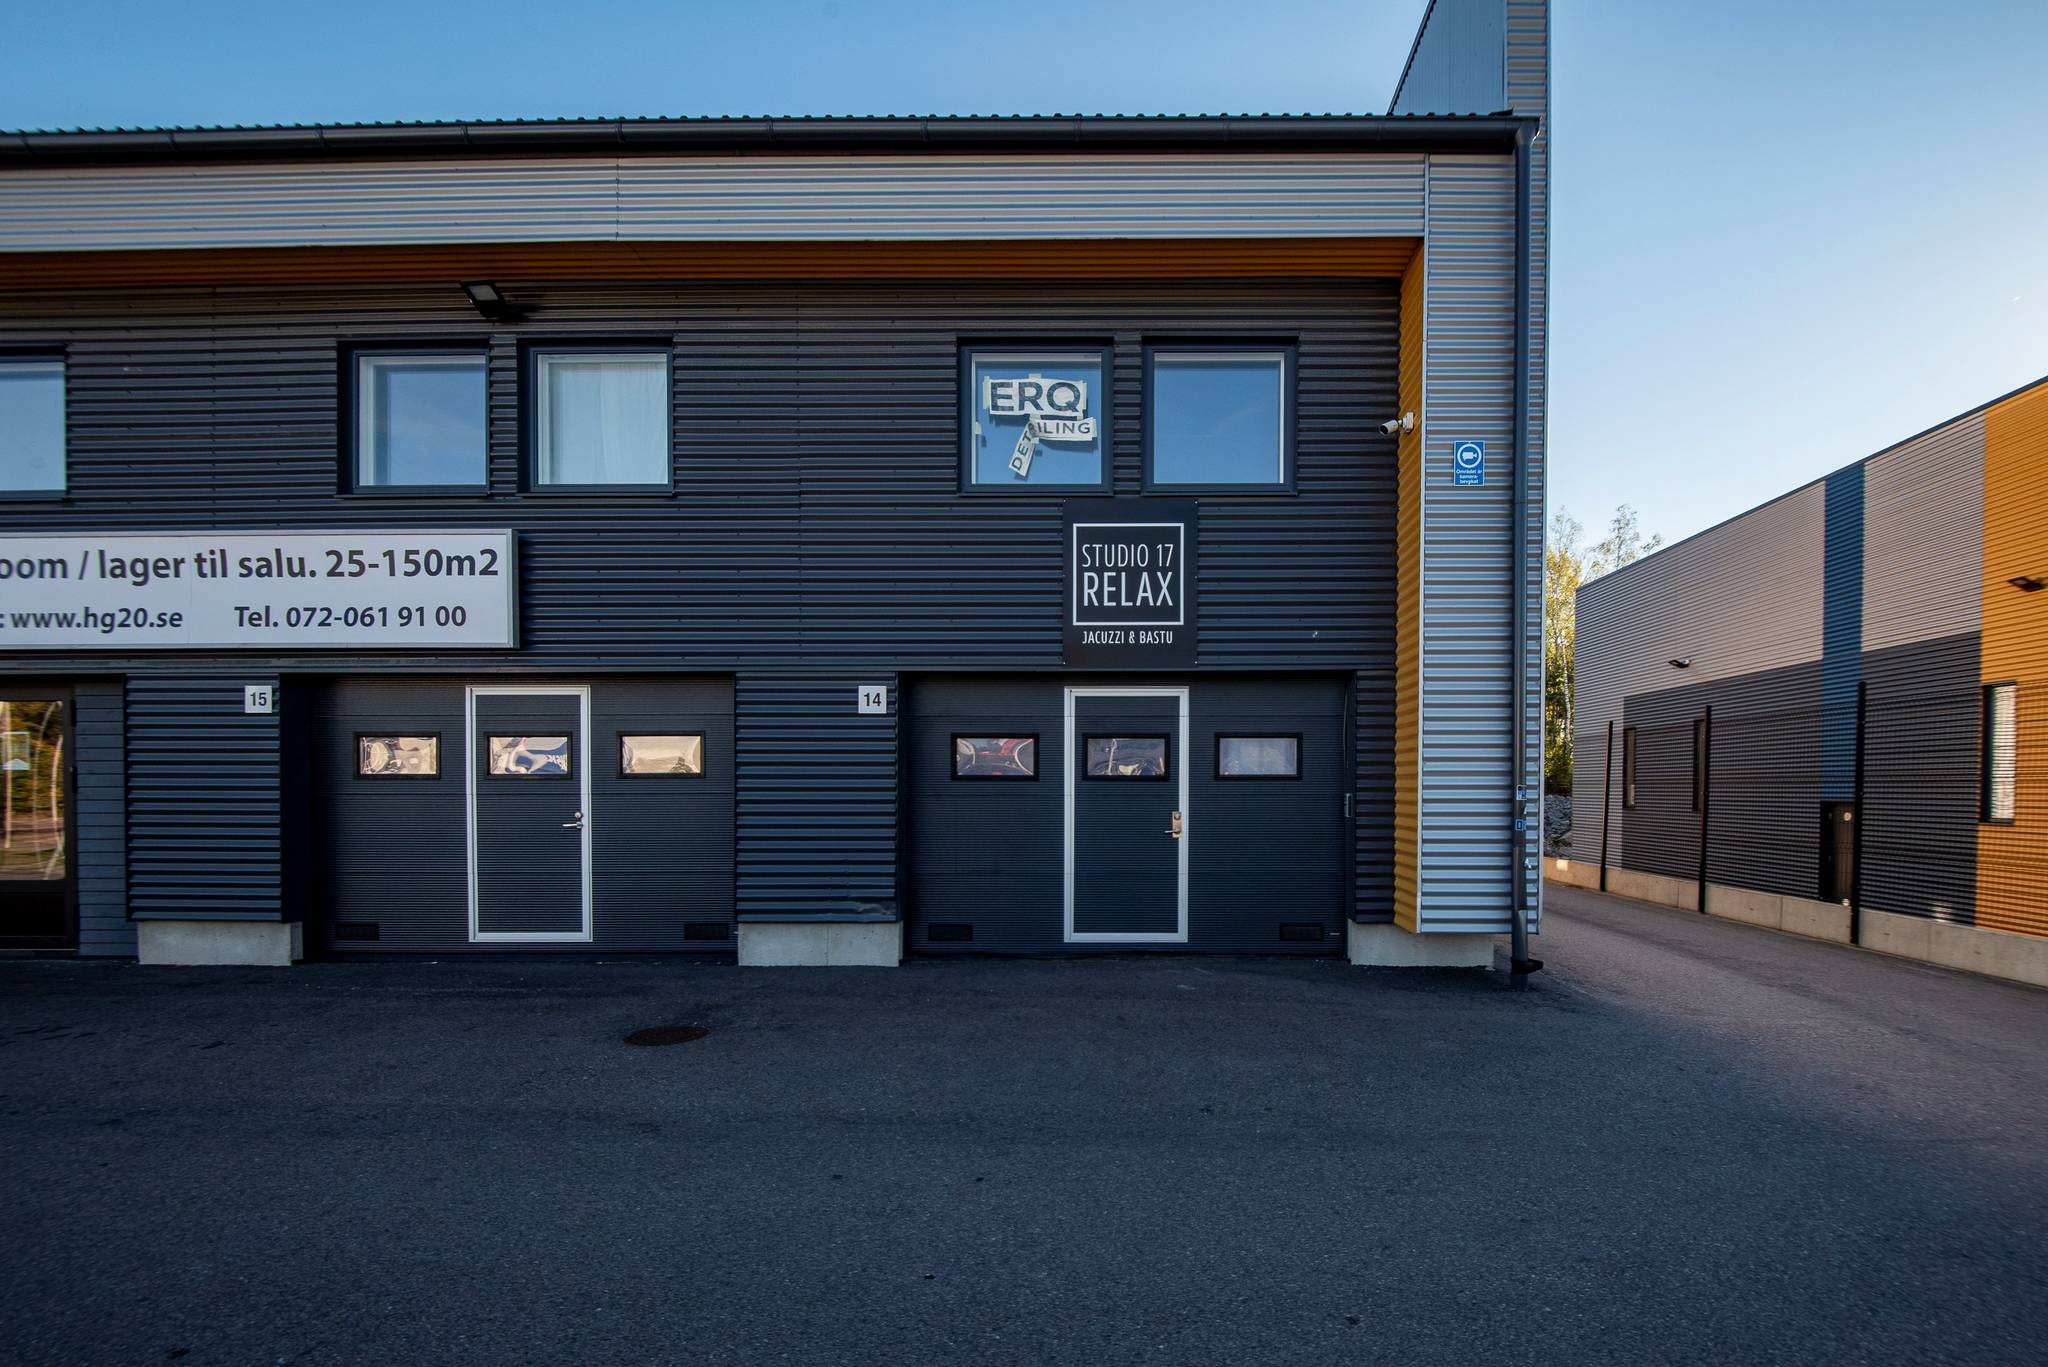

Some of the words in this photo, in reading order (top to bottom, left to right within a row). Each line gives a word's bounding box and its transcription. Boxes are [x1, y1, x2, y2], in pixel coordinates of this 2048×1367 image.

[990, 381, 1081, 413] ERQ
[78, 550, 89, 580] /
[98, 549, 186, 587] lager
[194, 548, 228, 579] til
[238, 548, 317, 578] salu.
[325, 548, 499, 578] 25-150m2
[1081, 543, 1149, 568] STUDIO
[1156, 543, 1174, 568] 17
[1083, 571, 1174, 607] RELAX
[10, 606, 184, 634] www.hg20.se
[234, 605, 279, 628] Tel.
[286, 606, 388, 628] 072-061
[398, 606, 425, 628] 91
[435, 605, 467, 627] 00
[1082, 631, 1125, 645] JACUZZI
[1128, 630, 1136, 645] &
[1139, 630, 1173, 645] BASTU
[250, 691, 267, 707] 15
[864, 692, 882, 707] 14
